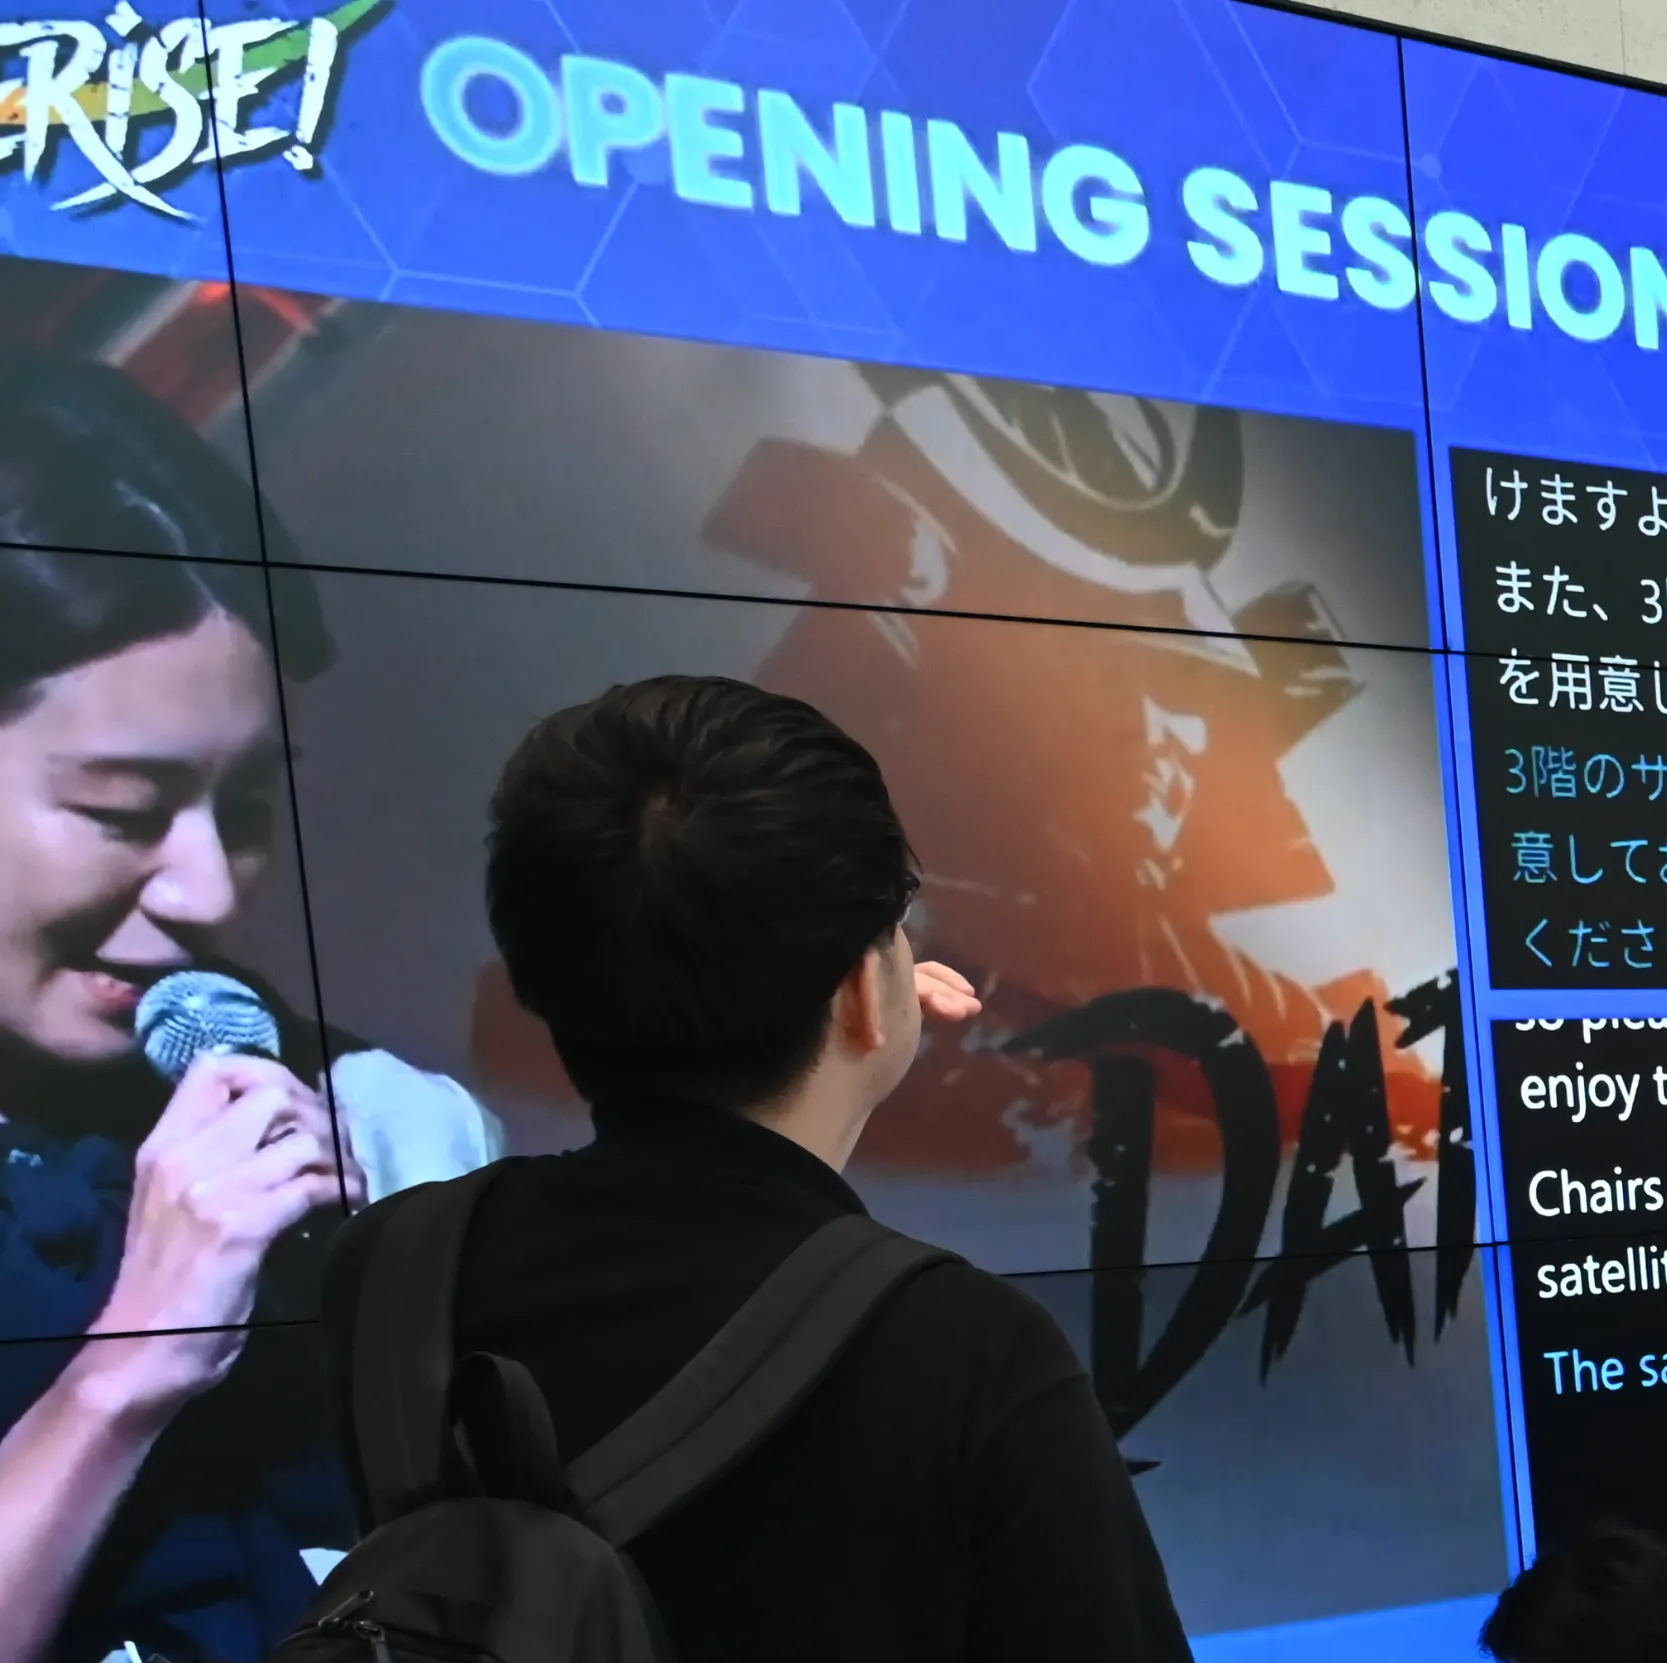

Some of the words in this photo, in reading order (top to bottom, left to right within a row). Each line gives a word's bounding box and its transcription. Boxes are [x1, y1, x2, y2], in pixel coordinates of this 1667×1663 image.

[420, 35, 1150, 268] OPENING
[1520, 1061, 1641, 1122] enjoy
[1528, 1167, 1664, 1217] Chairs
[1543, 1348, 1625, 1394] The
